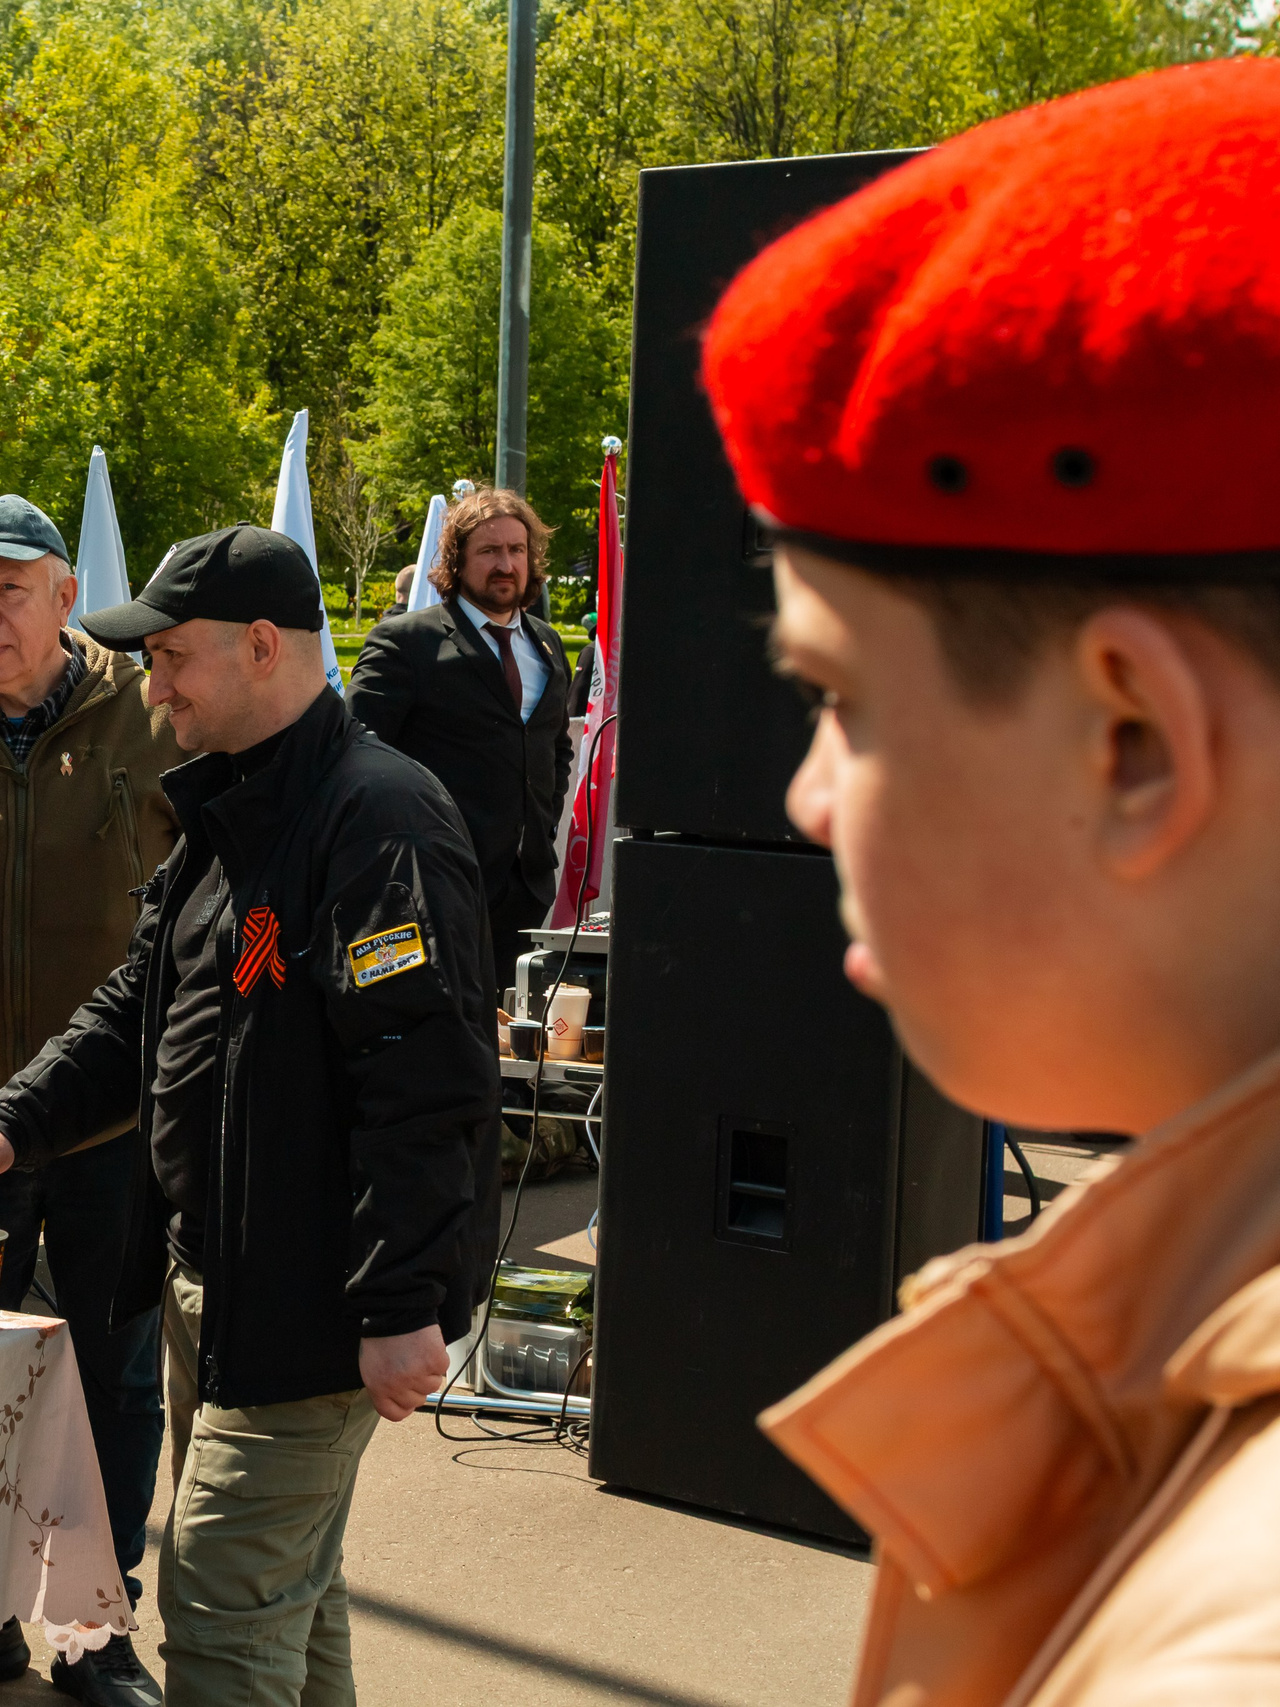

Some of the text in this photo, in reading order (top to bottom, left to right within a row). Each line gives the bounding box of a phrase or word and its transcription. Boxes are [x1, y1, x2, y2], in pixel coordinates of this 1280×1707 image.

[355, 931, 413, 957] МЫ РУССКИЕ
[361, 972, 367, 980] С
[369, 965, 396, 978] НАМИ
